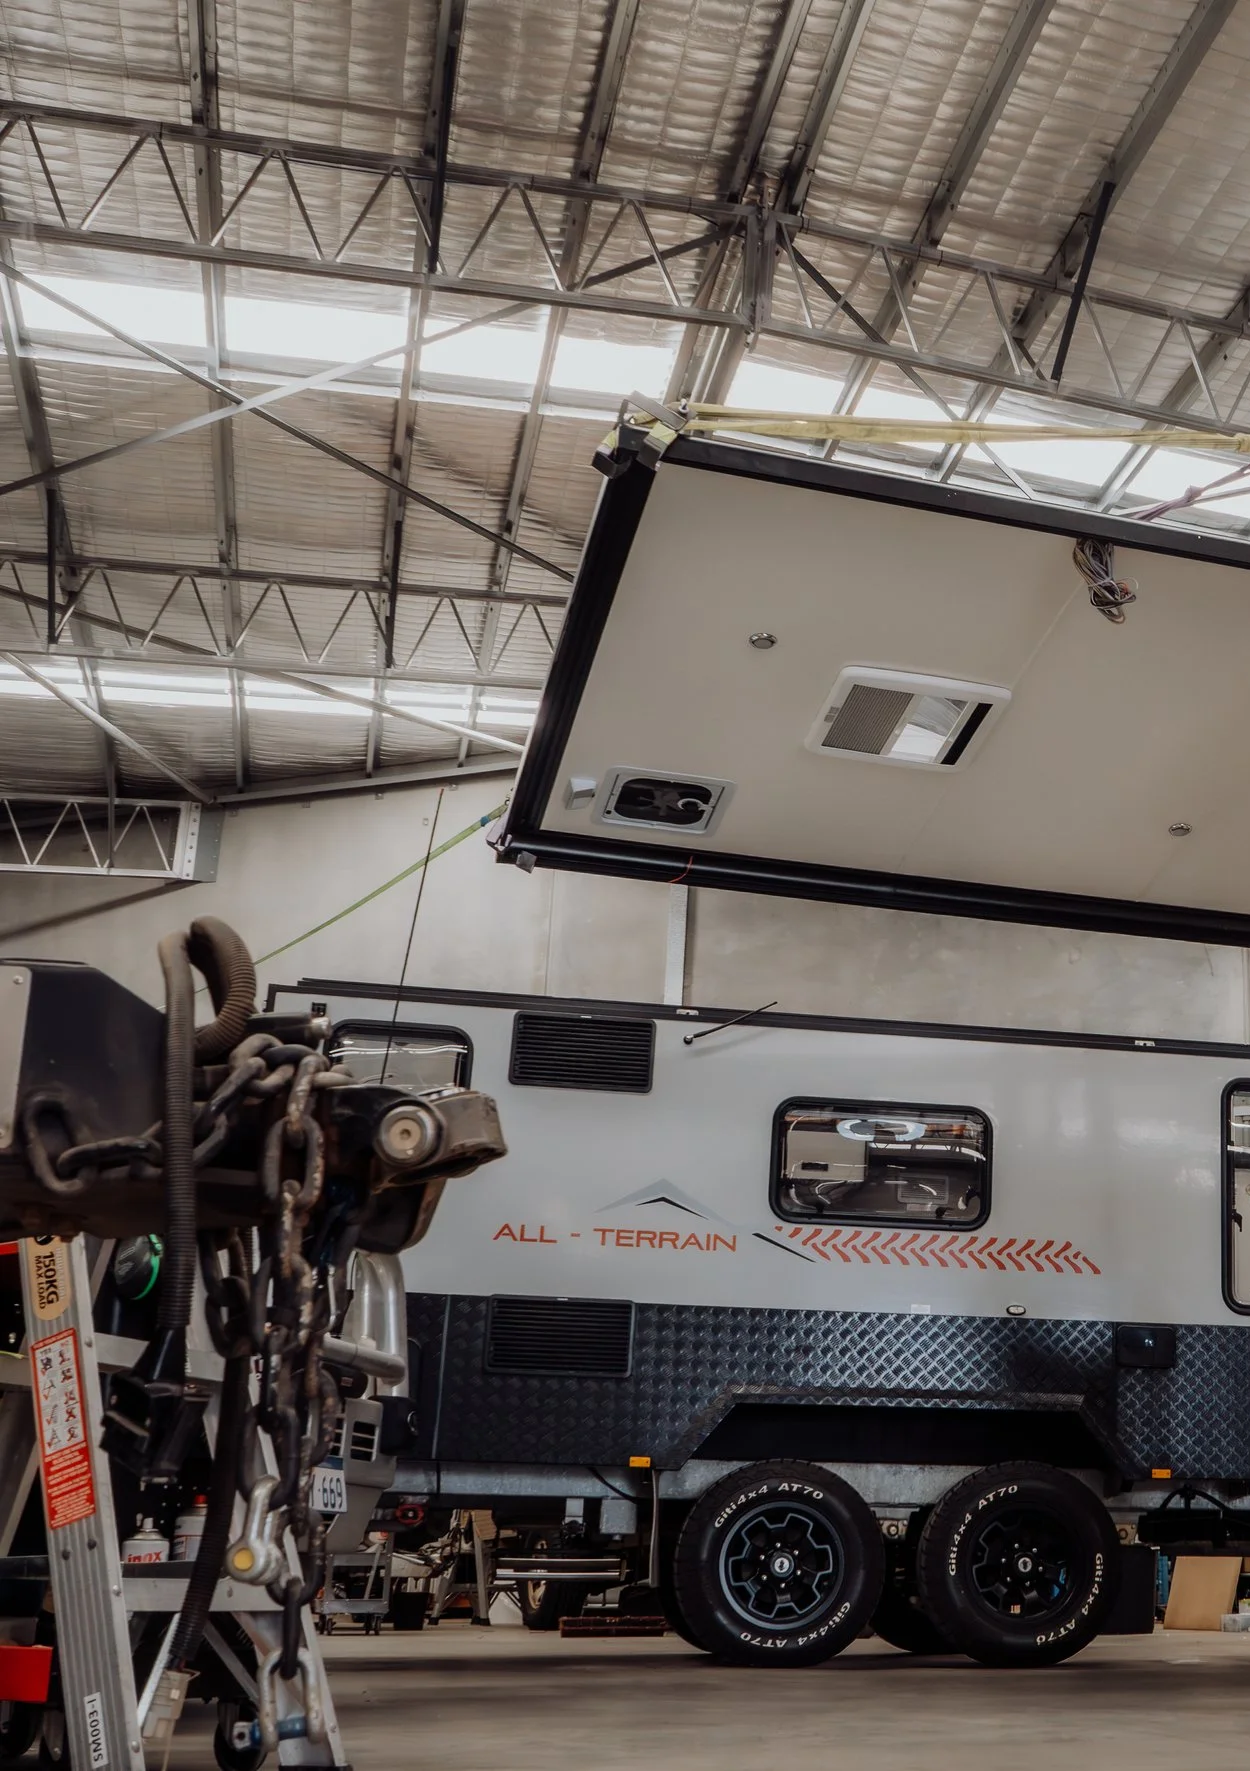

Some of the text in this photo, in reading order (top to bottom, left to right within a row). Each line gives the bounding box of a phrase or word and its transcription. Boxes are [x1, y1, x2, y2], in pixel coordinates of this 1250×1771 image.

[493, 1223, 558, 1244] ALL
[593, 1228, 737, 1253] TERRAIN
[34, 1255, 46, 1310] MAX LOAD
[42, 1251, 60, 1305] 150KG
[714, 1482, 824, 1528] Giti4x4 AT70
[978, 1485, 1018, 1510] AT70
[740, 1632, 788, 1648] AT70
[1036, 1619, 1076, 1646] AT70
